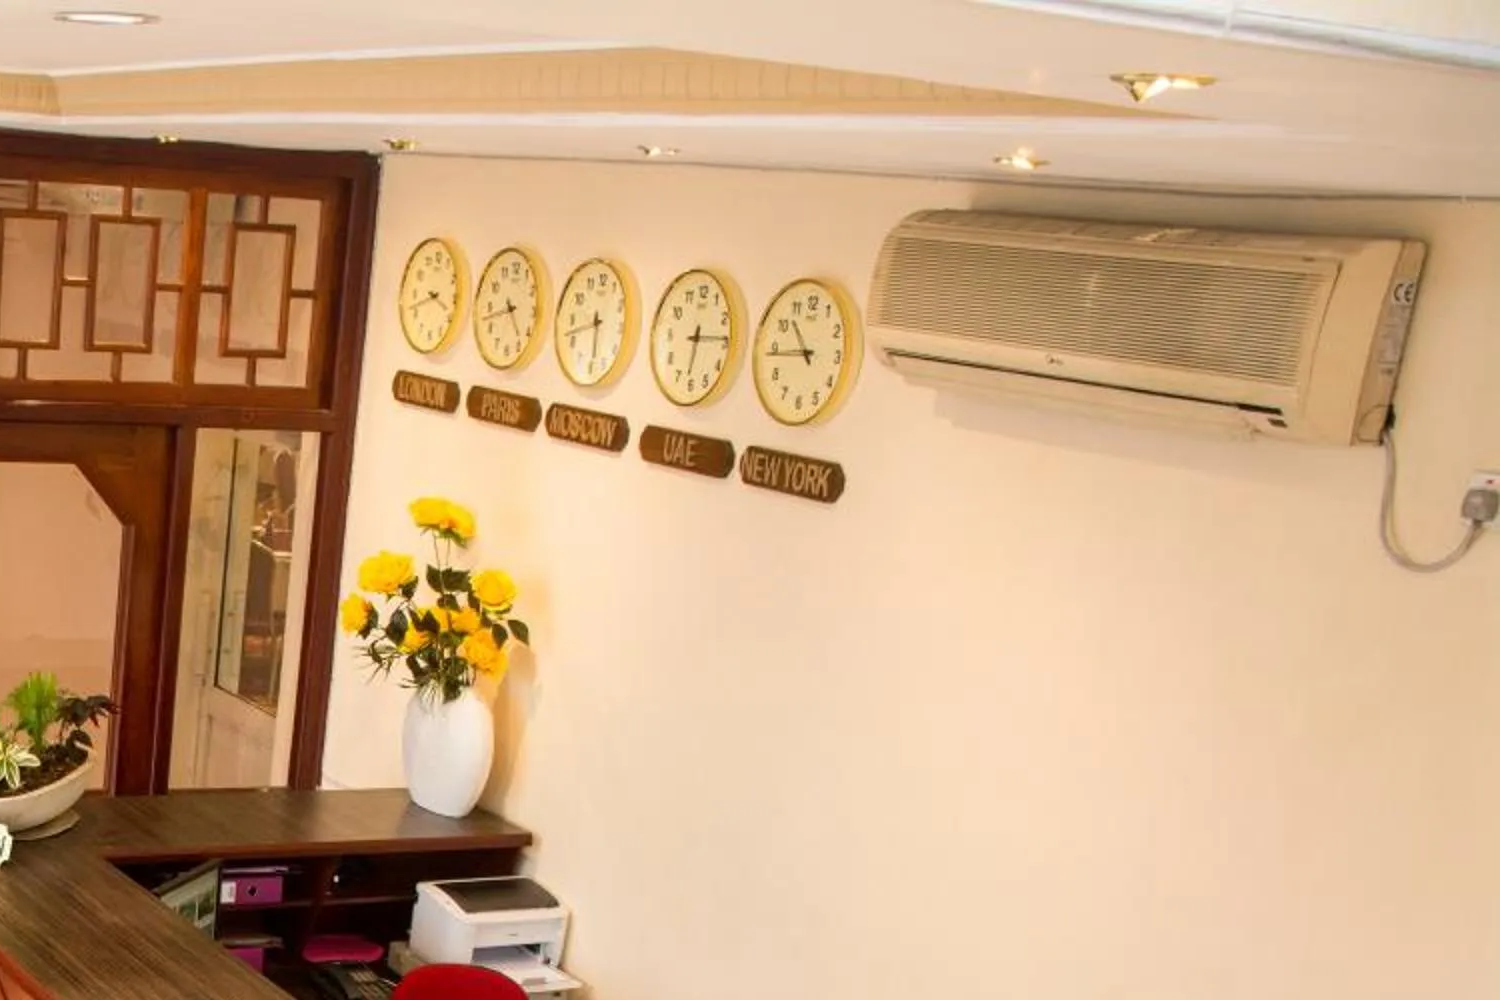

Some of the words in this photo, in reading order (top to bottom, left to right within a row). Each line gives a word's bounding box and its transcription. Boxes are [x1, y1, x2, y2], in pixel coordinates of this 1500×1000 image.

[699, 285, 709, 299] 12
[793, 301, 802, 315] 11
[808, 296, 819, 310] 12
[826, 304, 831, 318] 1
[778, 319, 789, 333] 10
[833, 324, 841, 339] 2
[834, 350, 841, 364] 3
[396, 374, 447, 409] LONDON
[782, 386, 788, 400] 7
[481, 392, 521, 425] PARIS
[549, 407, 618, 448] MOSCOW
[663, 433, 698, 467] UAE
[742, 450, 782, 487] NEW
[784, 458, 833, 498] YORK
